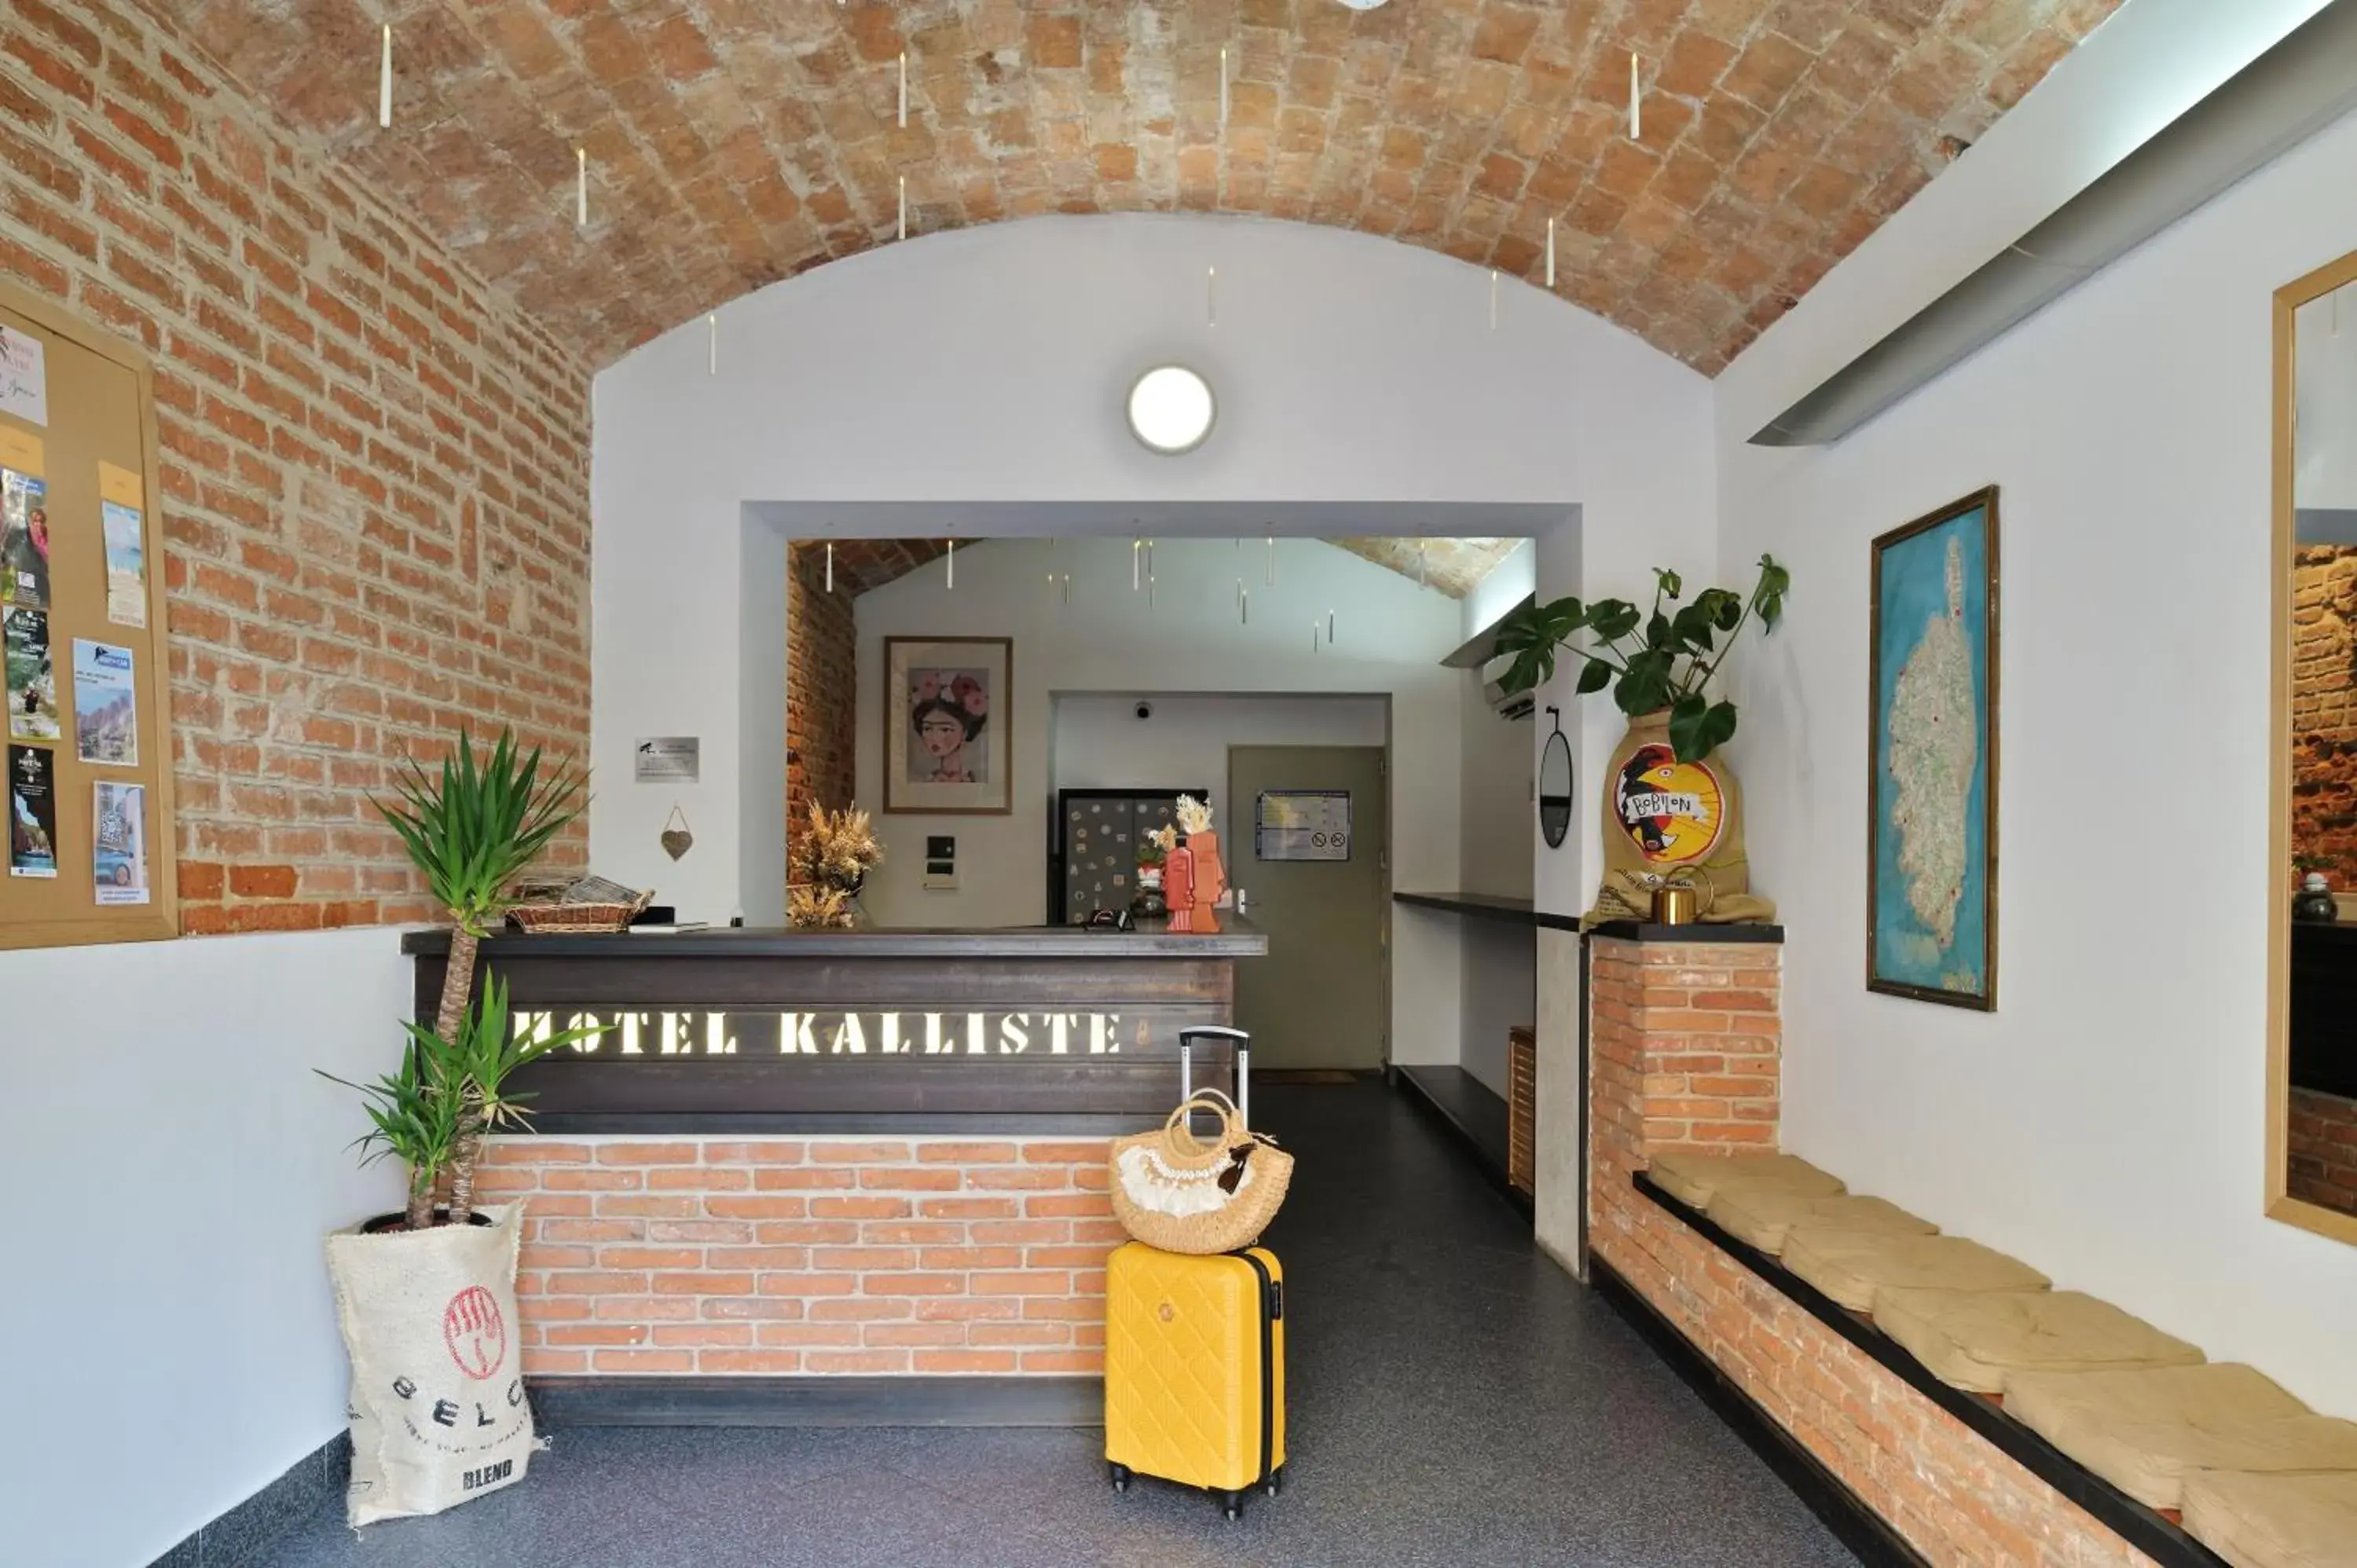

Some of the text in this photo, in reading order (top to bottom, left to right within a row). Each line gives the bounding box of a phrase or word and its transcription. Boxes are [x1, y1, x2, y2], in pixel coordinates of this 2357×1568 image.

[513, 1010, 1121, 1054] HOTEL KALLISTE
[462, 1458, 514, 1491] BLEND
